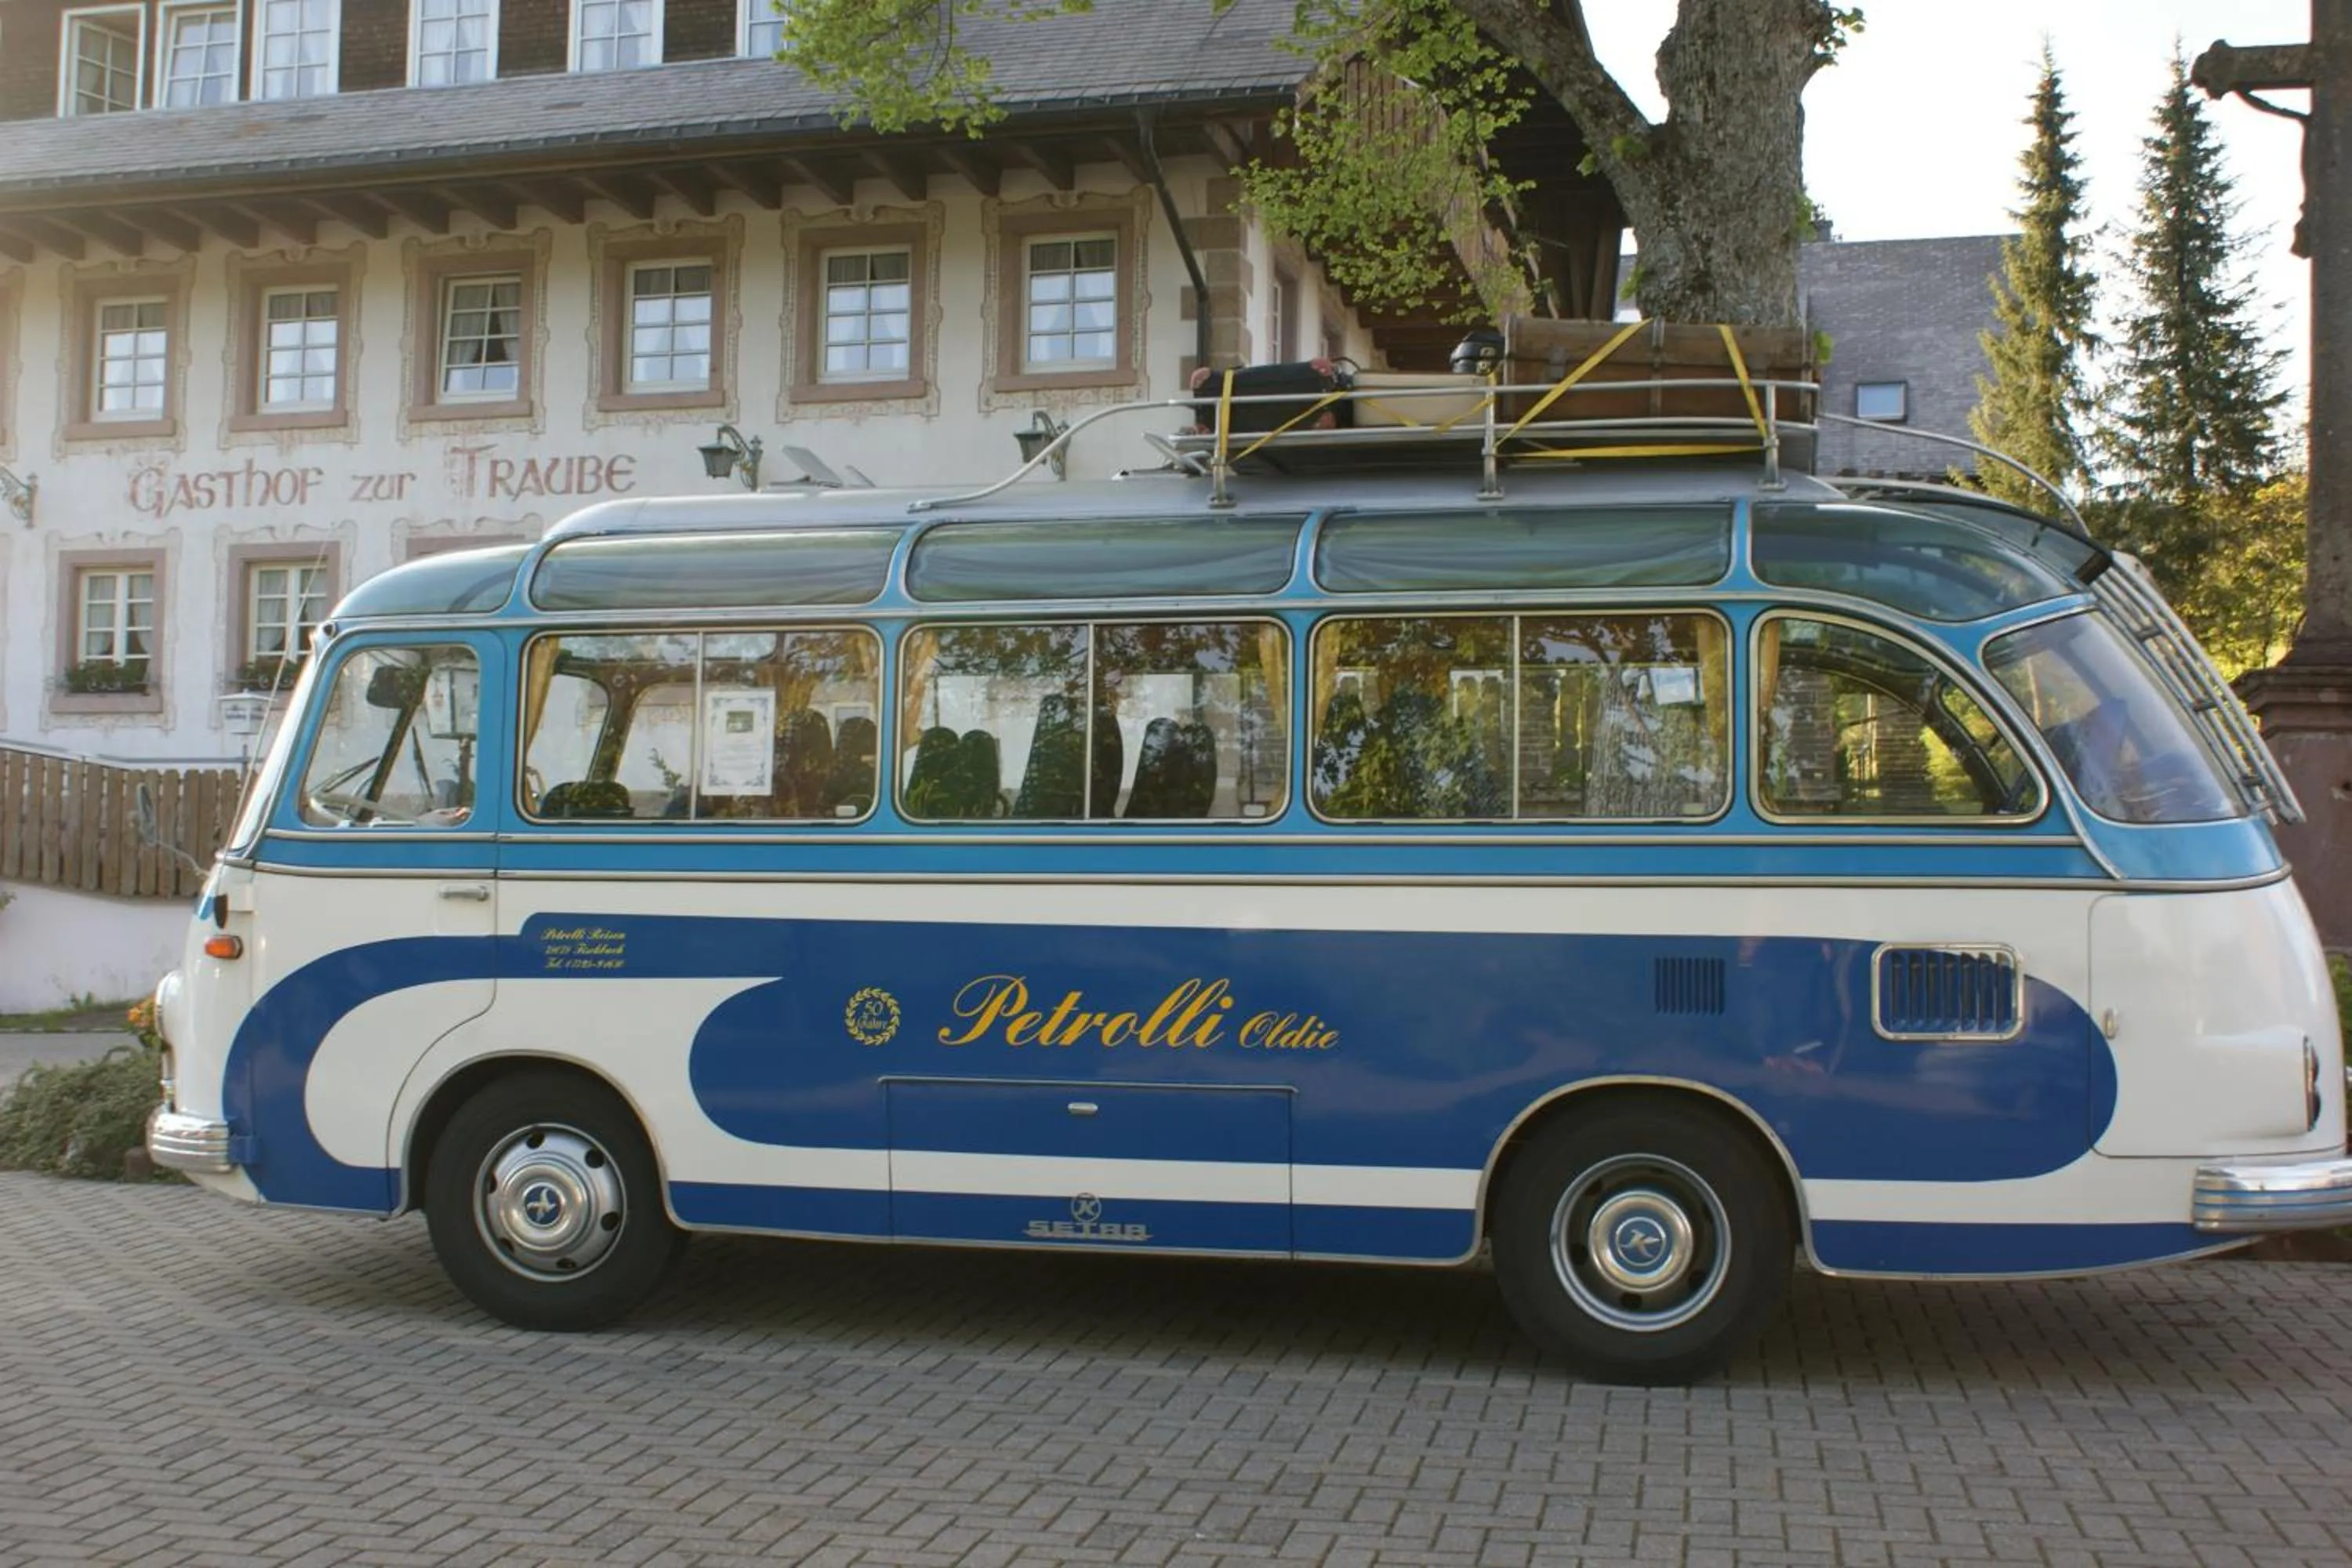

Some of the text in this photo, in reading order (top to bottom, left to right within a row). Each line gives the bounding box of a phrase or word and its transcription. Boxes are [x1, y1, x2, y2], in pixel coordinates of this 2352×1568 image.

[350, 473, 417, 502] zur
[450, 444, 637, 502] TRAUBE
[938, 975, 1340, 1049] Petrolli Oldie
[1026, 1220, 1148, 1240] SETRA
